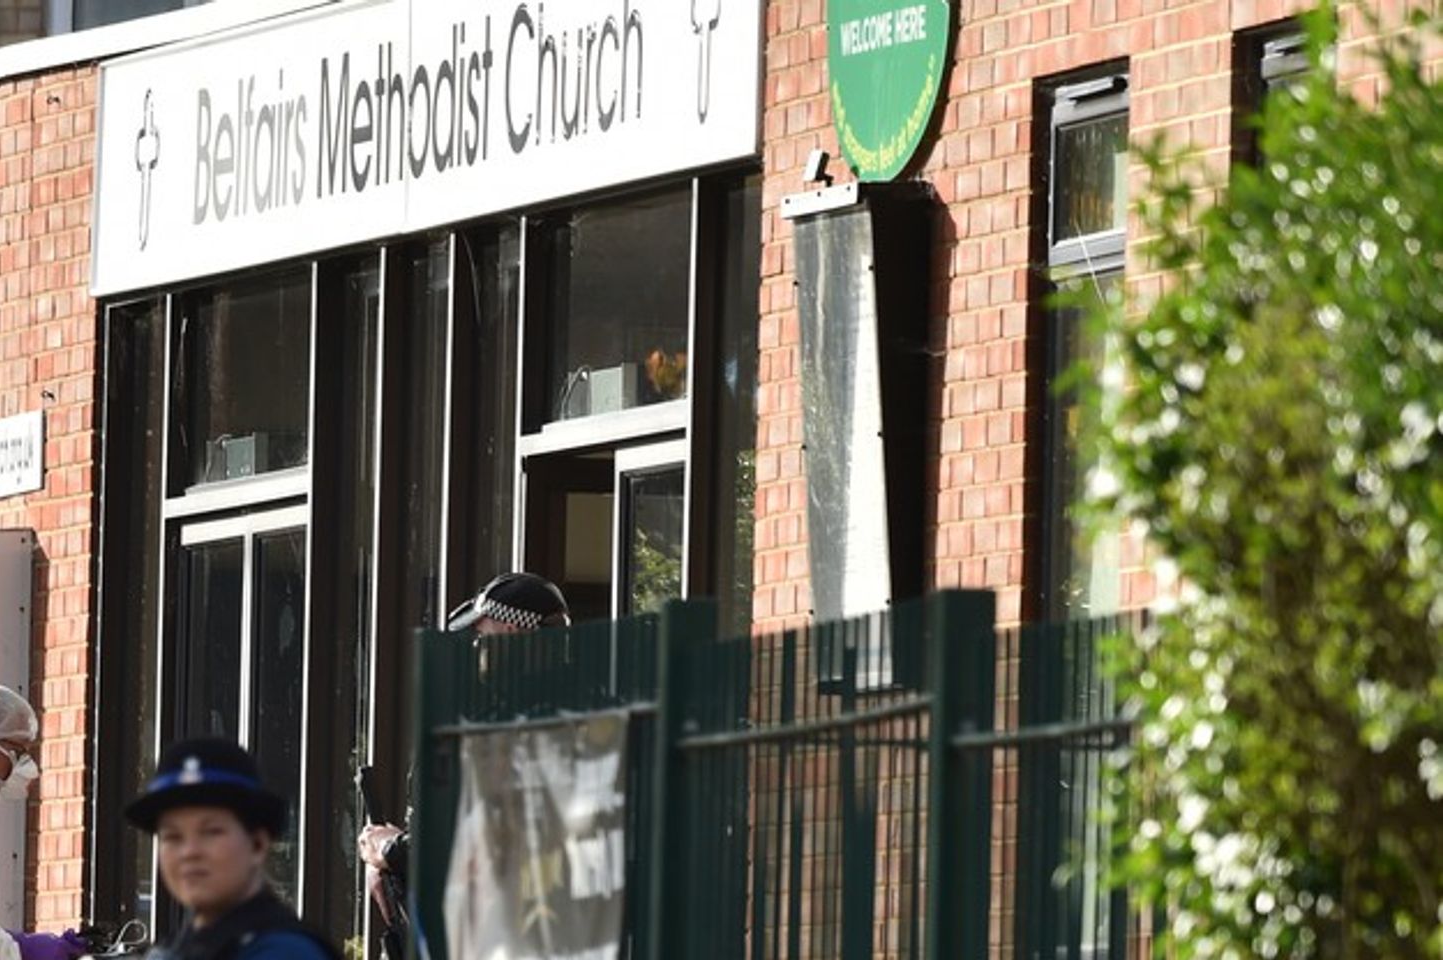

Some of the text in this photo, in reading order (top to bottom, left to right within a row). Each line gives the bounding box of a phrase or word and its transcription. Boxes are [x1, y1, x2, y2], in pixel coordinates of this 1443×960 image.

[840, 5, 927, 56] WELCOME HERE
[193, 67, 307, 225] Belfairs
[316, 14, 493, 199] Methodist
[505, 0, 644, 155] Church
